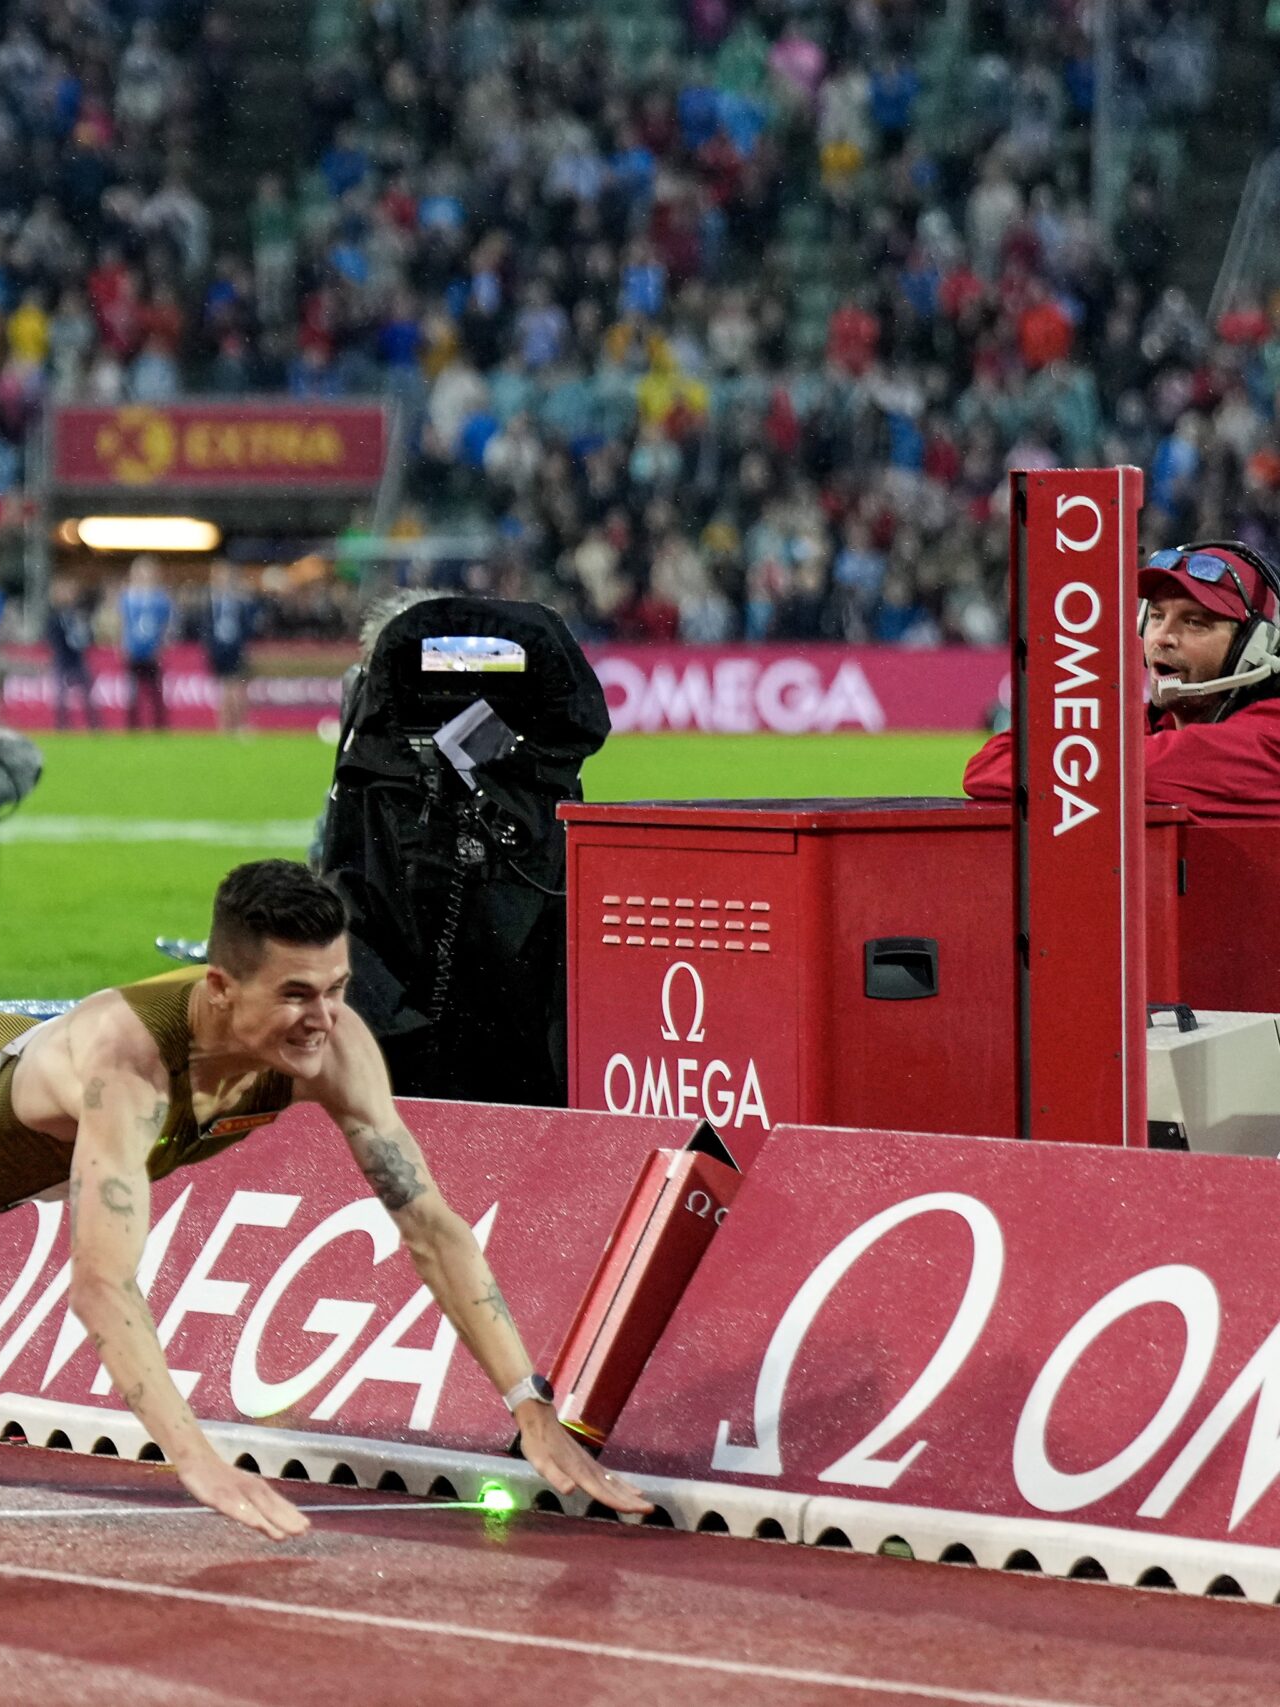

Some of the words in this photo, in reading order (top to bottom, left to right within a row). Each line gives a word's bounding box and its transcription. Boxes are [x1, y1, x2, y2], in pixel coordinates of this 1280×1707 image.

[592, 656, 888, 735] OMEGA
[1053, 581, 1101, 837] OMEGA
[604, 1053, 771, 1131] OMEGA
